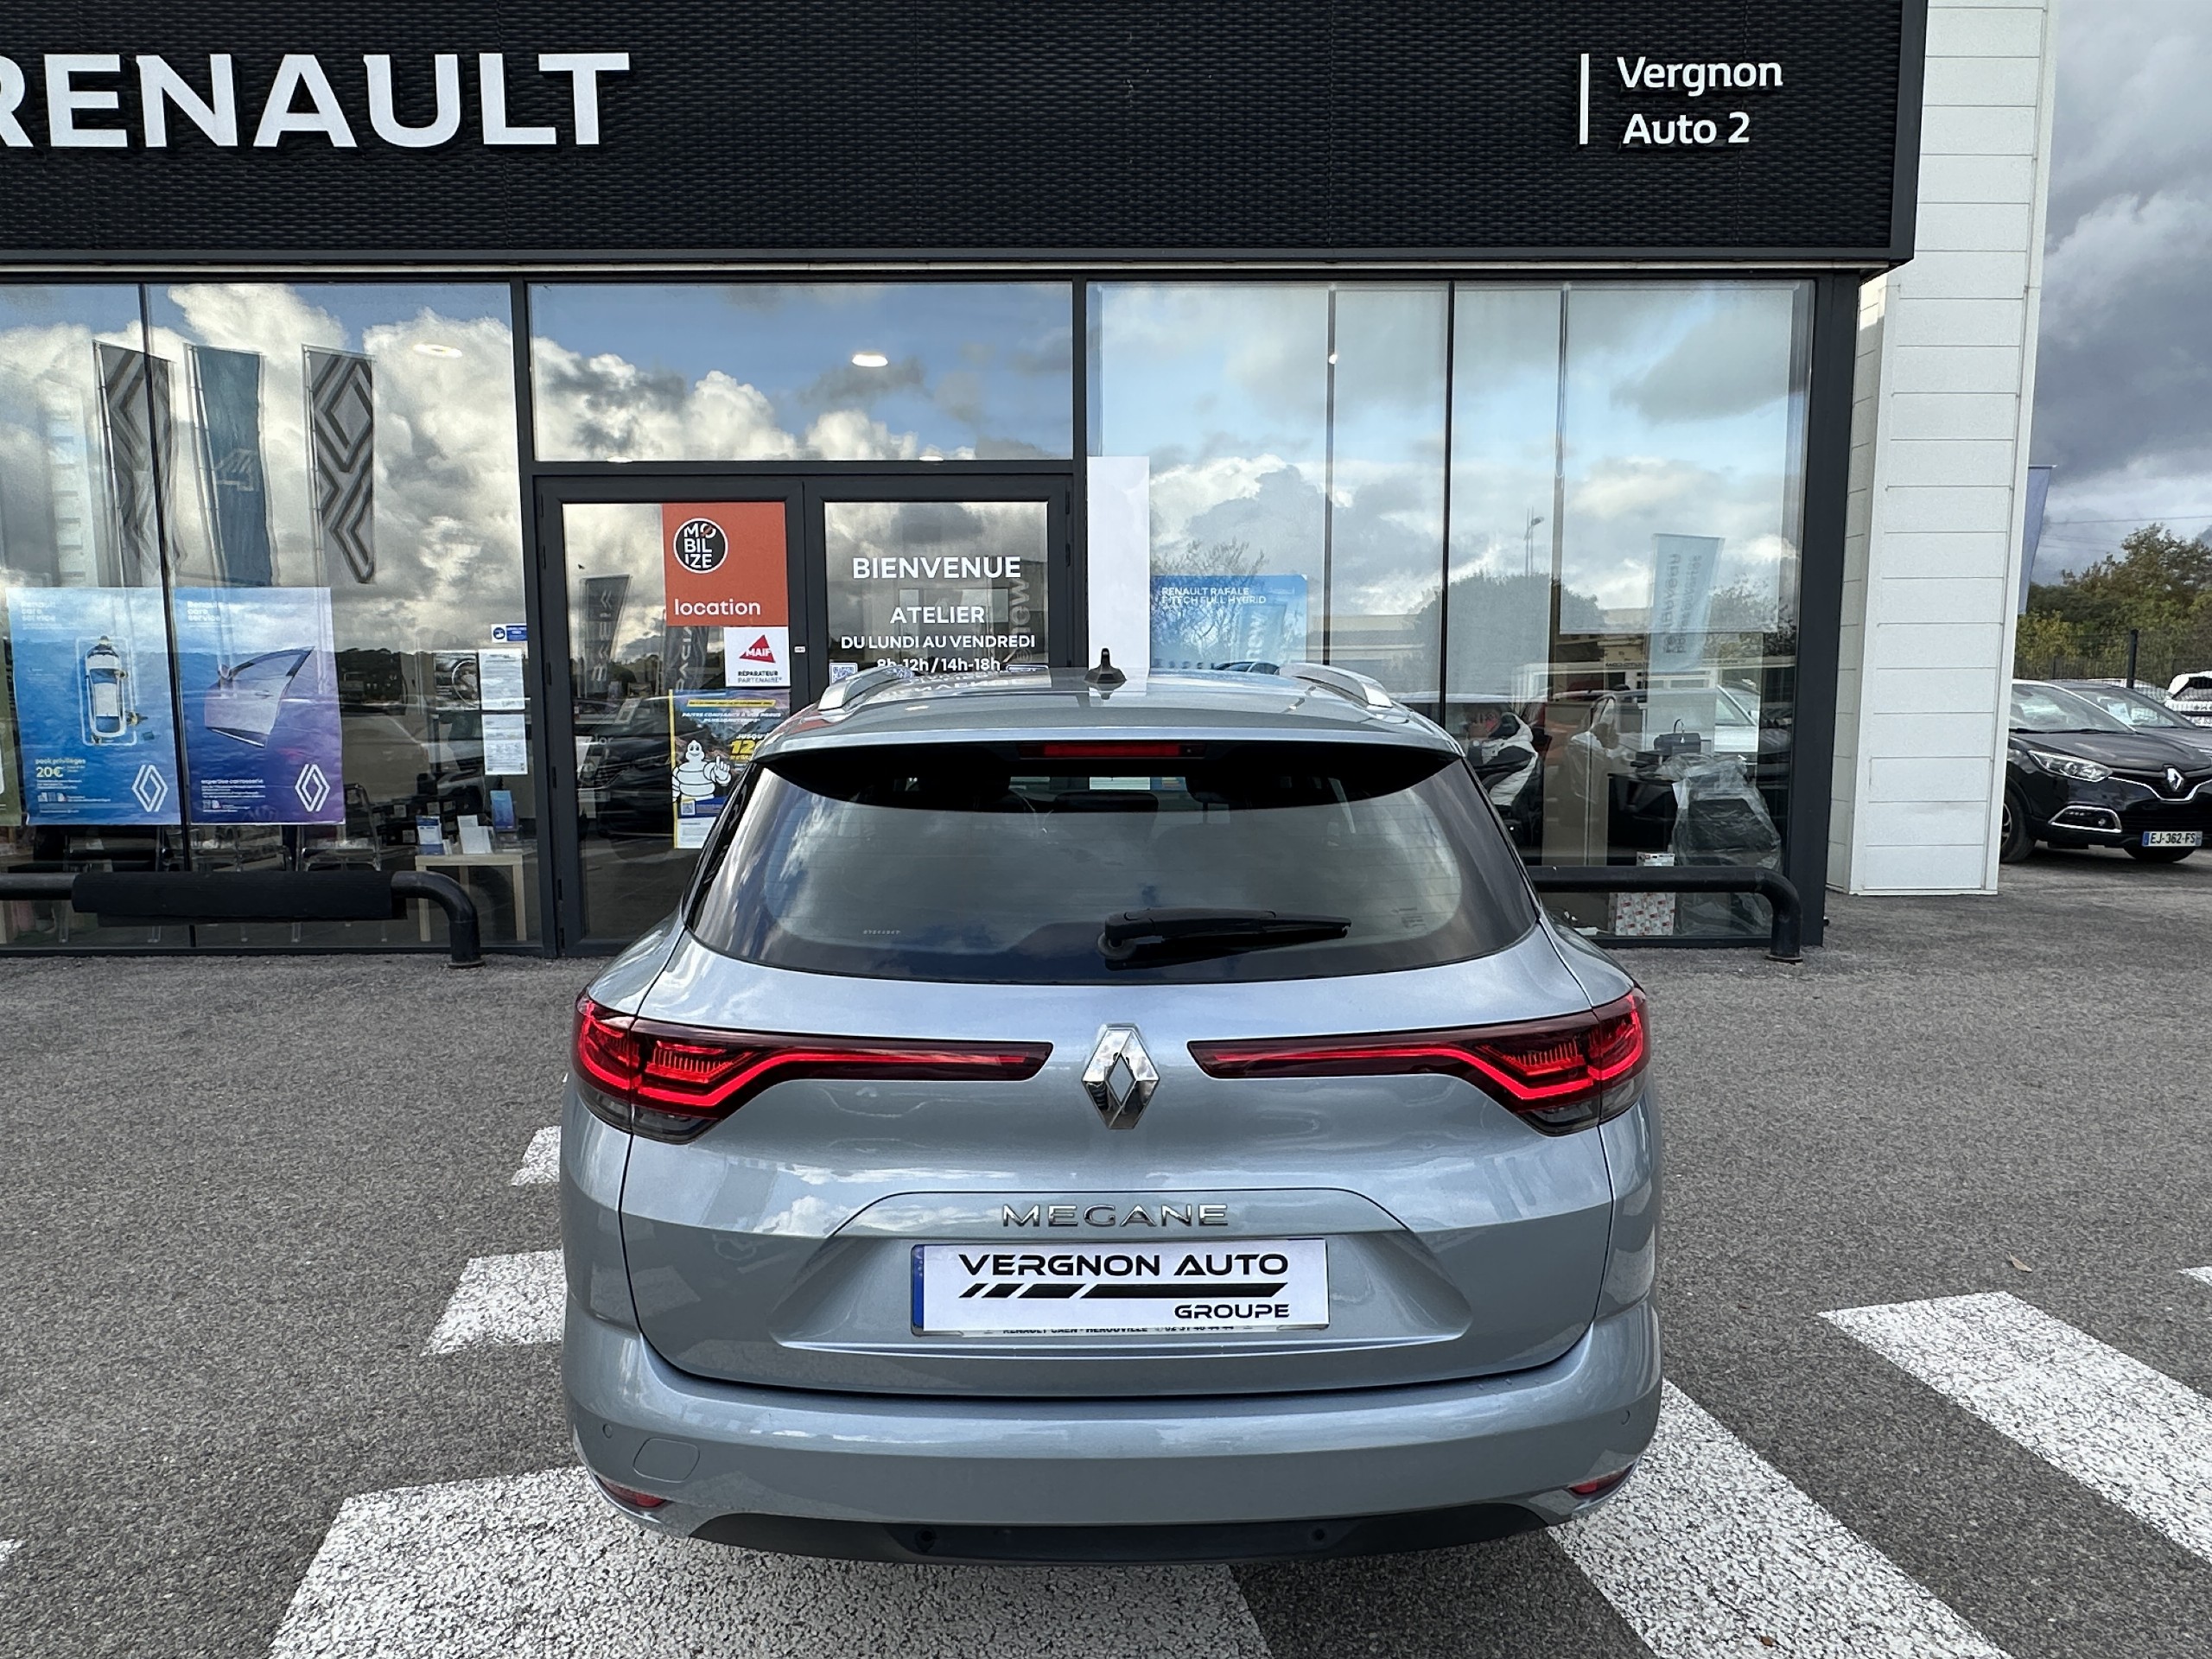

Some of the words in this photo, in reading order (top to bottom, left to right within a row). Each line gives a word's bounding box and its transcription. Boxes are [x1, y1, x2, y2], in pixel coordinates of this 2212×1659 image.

[1616, 56, 1783, 97] Vergnon
[1622, 113, 1717, 144] Auto
[1727, 111, 1750, 143] 2
[853, 556, 1021, 579] BIENVENUE
[1161, 587, 1209, 596] RENAULT
[1210, 587, 1249, 595] RAFALE
[674, 598, 761, 617] location
[889, 606, 985, 624] ATELIER
[841, 636, 865, 649] DU
[868, 635, 919, 649] LUNDI
[922, 635, 947, 648] AU
[950, 635, 1035, 648] VENDREDI
[746, 646, 772, 657] MAIF
[941, 658, 1001, 671] 14h-18h
[730, 740, 761, 754] 12
[2150, 832, 2196, 844] EJ-362-FS
[1001, 1204, 1229, 1228] MEGANE
[958, 1253, 1160, 1277] VERGNON
[1173, 1252, 1289, 1276] AUTO
[1174, 1305, 1290, 1319] GROUPE
